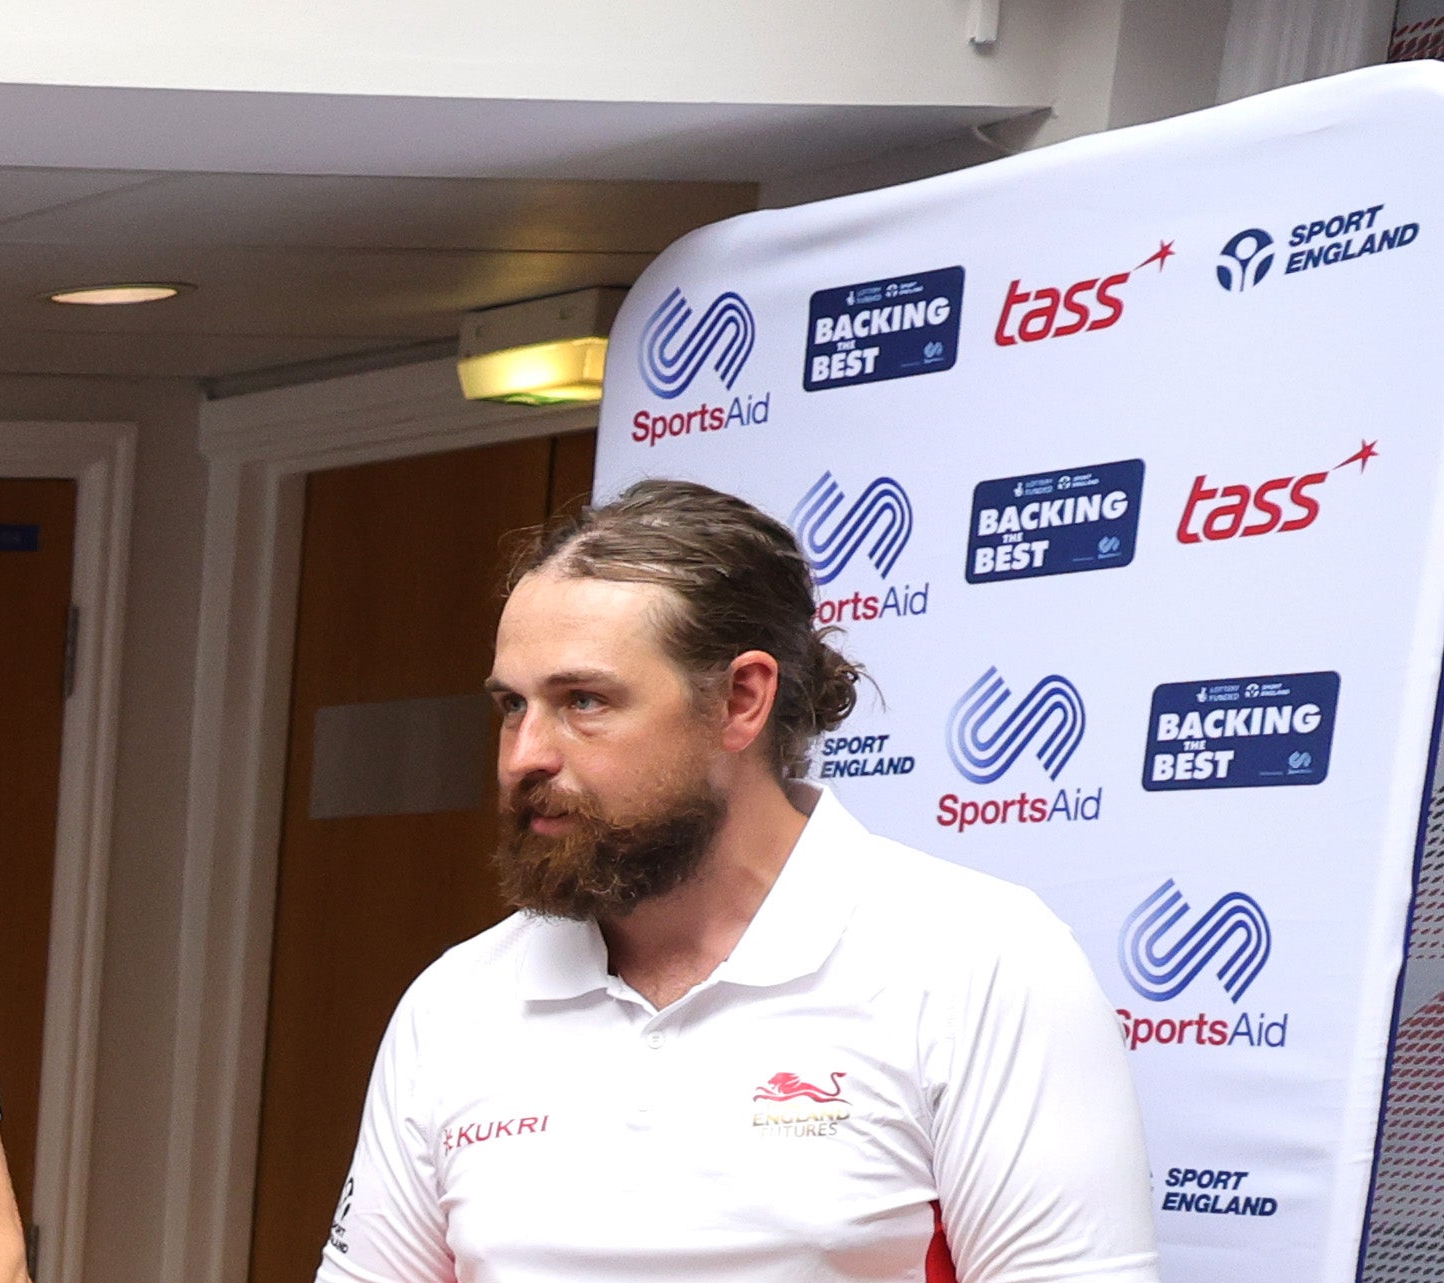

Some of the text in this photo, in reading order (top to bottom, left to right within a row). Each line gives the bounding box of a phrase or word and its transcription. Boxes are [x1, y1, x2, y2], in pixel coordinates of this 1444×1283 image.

[1287, 203, 1385, 248] SPORT
[1284, 222, 1421, 275] ENGLAND
[814, 296, 951, 344] BACKING
[994, 271, 1131, 347] tass
[836, 339, 856, 352] THE
[810, 346, 881, 382] BEST
[632, 392, 770, 447] SportsAid
[978, 490, 1129, 536] BACKING
[1176, 470, 1330, 545] tass
[1002, 532, 1023, 544] THE
[973, 541, 1049, 575] BEST
[812, 582, 929, 624] ortsAid
[1156, 703, 1322, 742] BACKING
[822, 734, 890, 757] SPORT
[1183, 740, 1207, 751] THE
[820, 755, 915, 780] ENGLAND
[1151, 751, 1235, 782] BEST
[936, 787, 1103, 833] SportsAid
[456, 1115, 550, 1148] KUKRI
[1164, 1167, 1249, 1191] SPORT
[1161, 1192, 1279, 1217] ENGLAND
